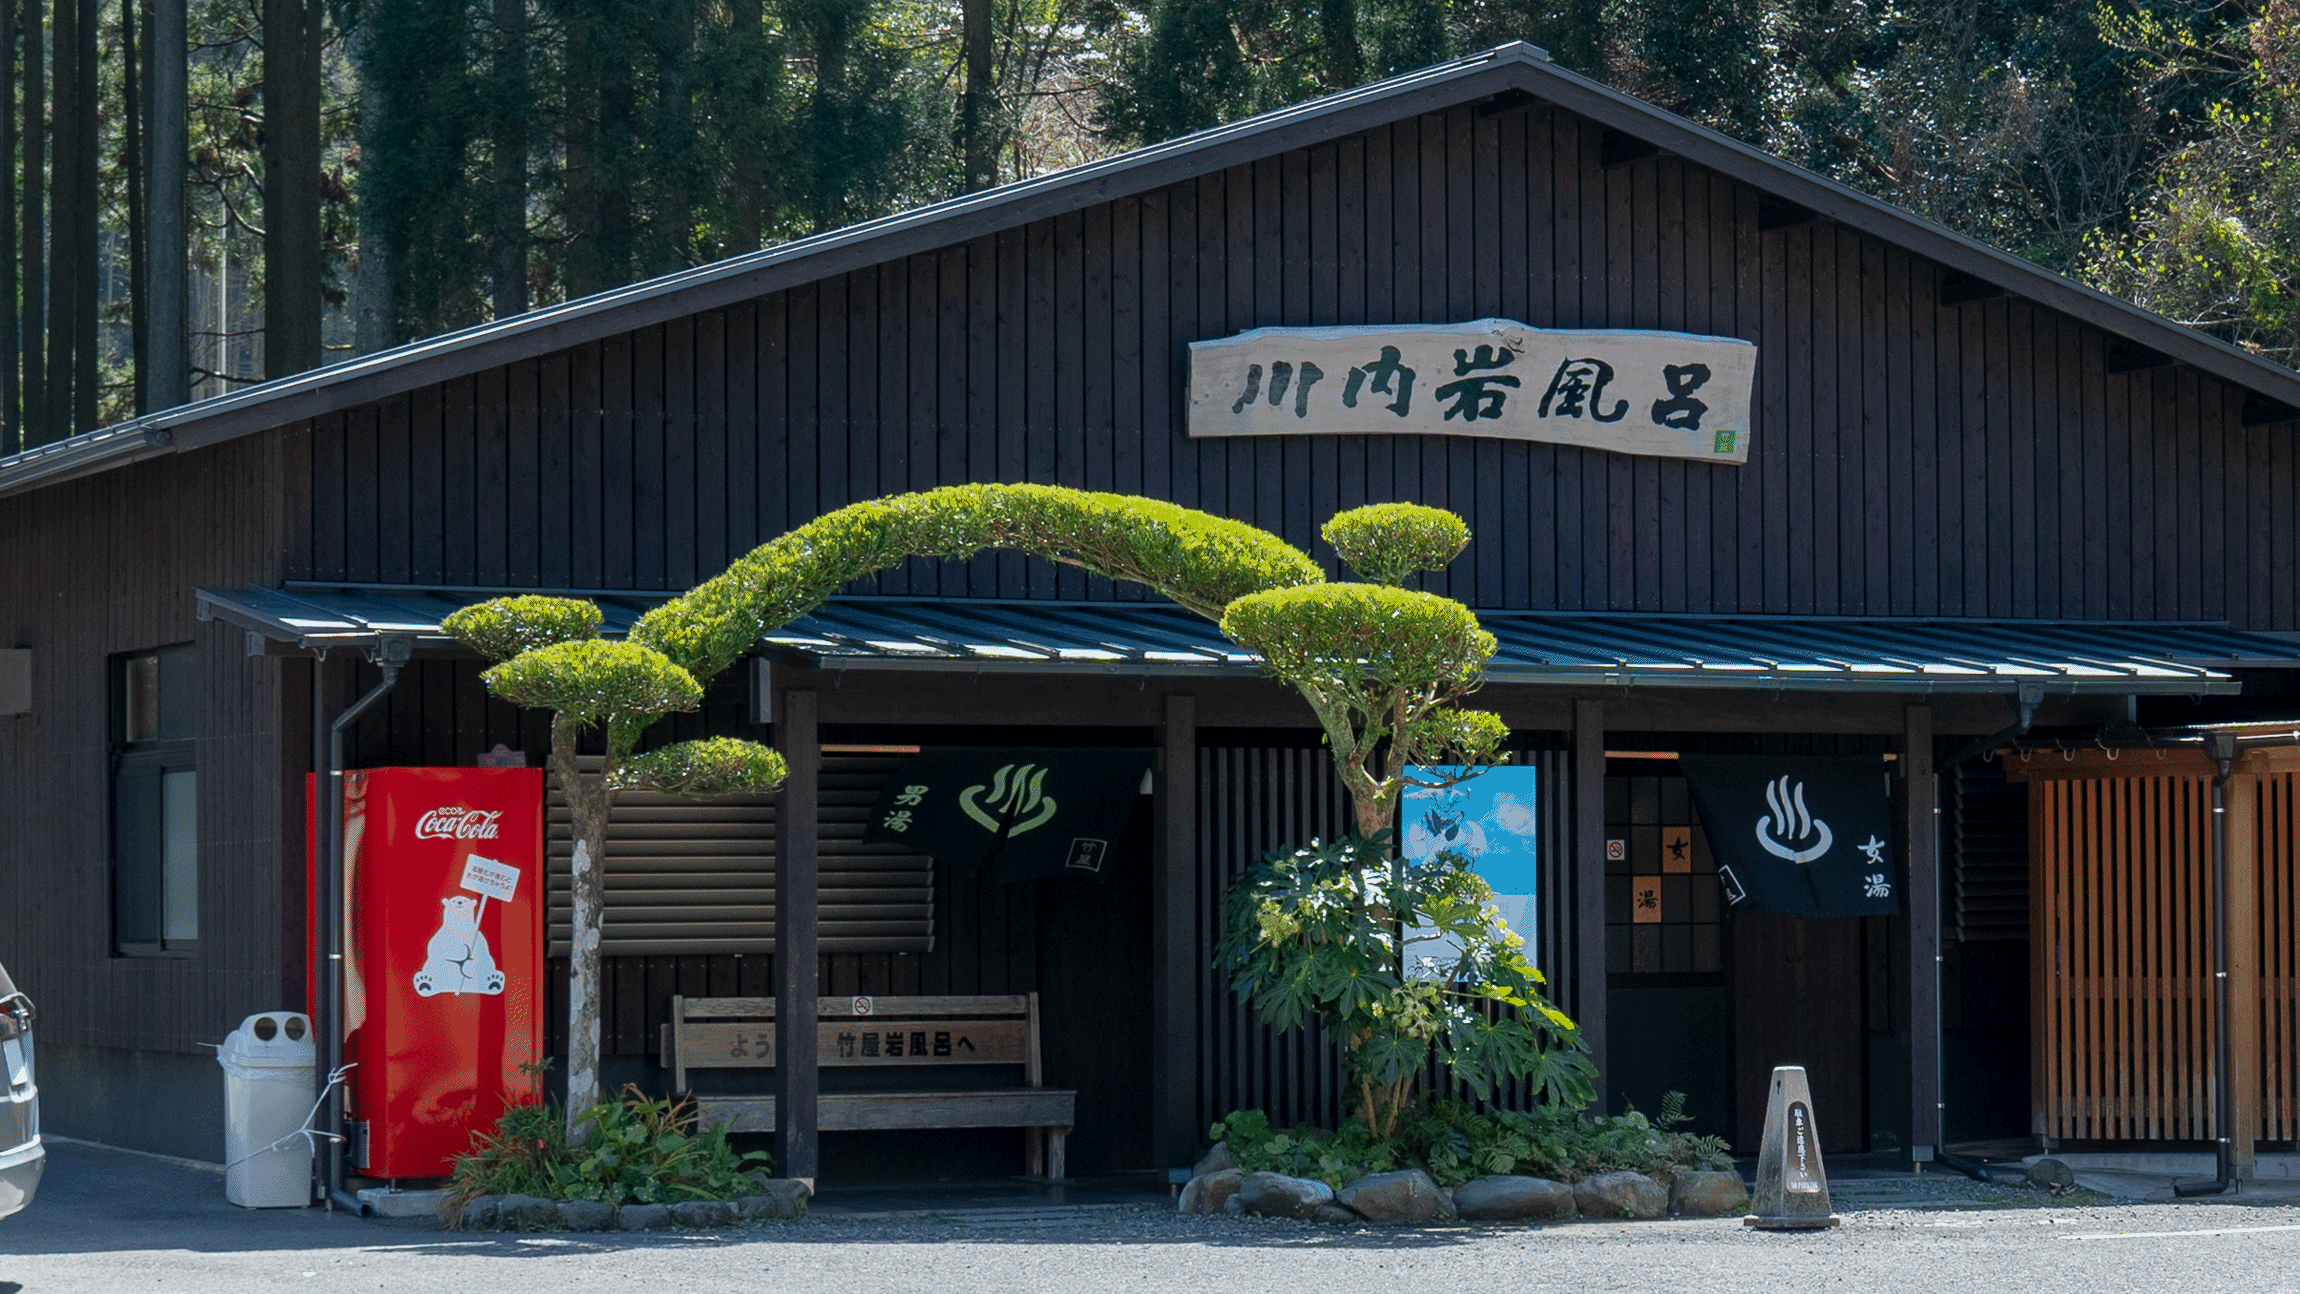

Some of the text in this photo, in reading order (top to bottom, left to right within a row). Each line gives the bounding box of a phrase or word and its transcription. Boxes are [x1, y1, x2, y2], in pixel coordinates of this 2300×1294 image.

[1232, 344, 1711, 430] 川内岩風呂
[415, 810, 503, 840] Coca-Cola
[883, 784, 928, 832] 男湯
[1637, 837, 1688, 910] 女 湯
[1857, 834, 1891, 899] 女湯
[836, 1031, 975, 1058] 竹屋岩風呂へ
